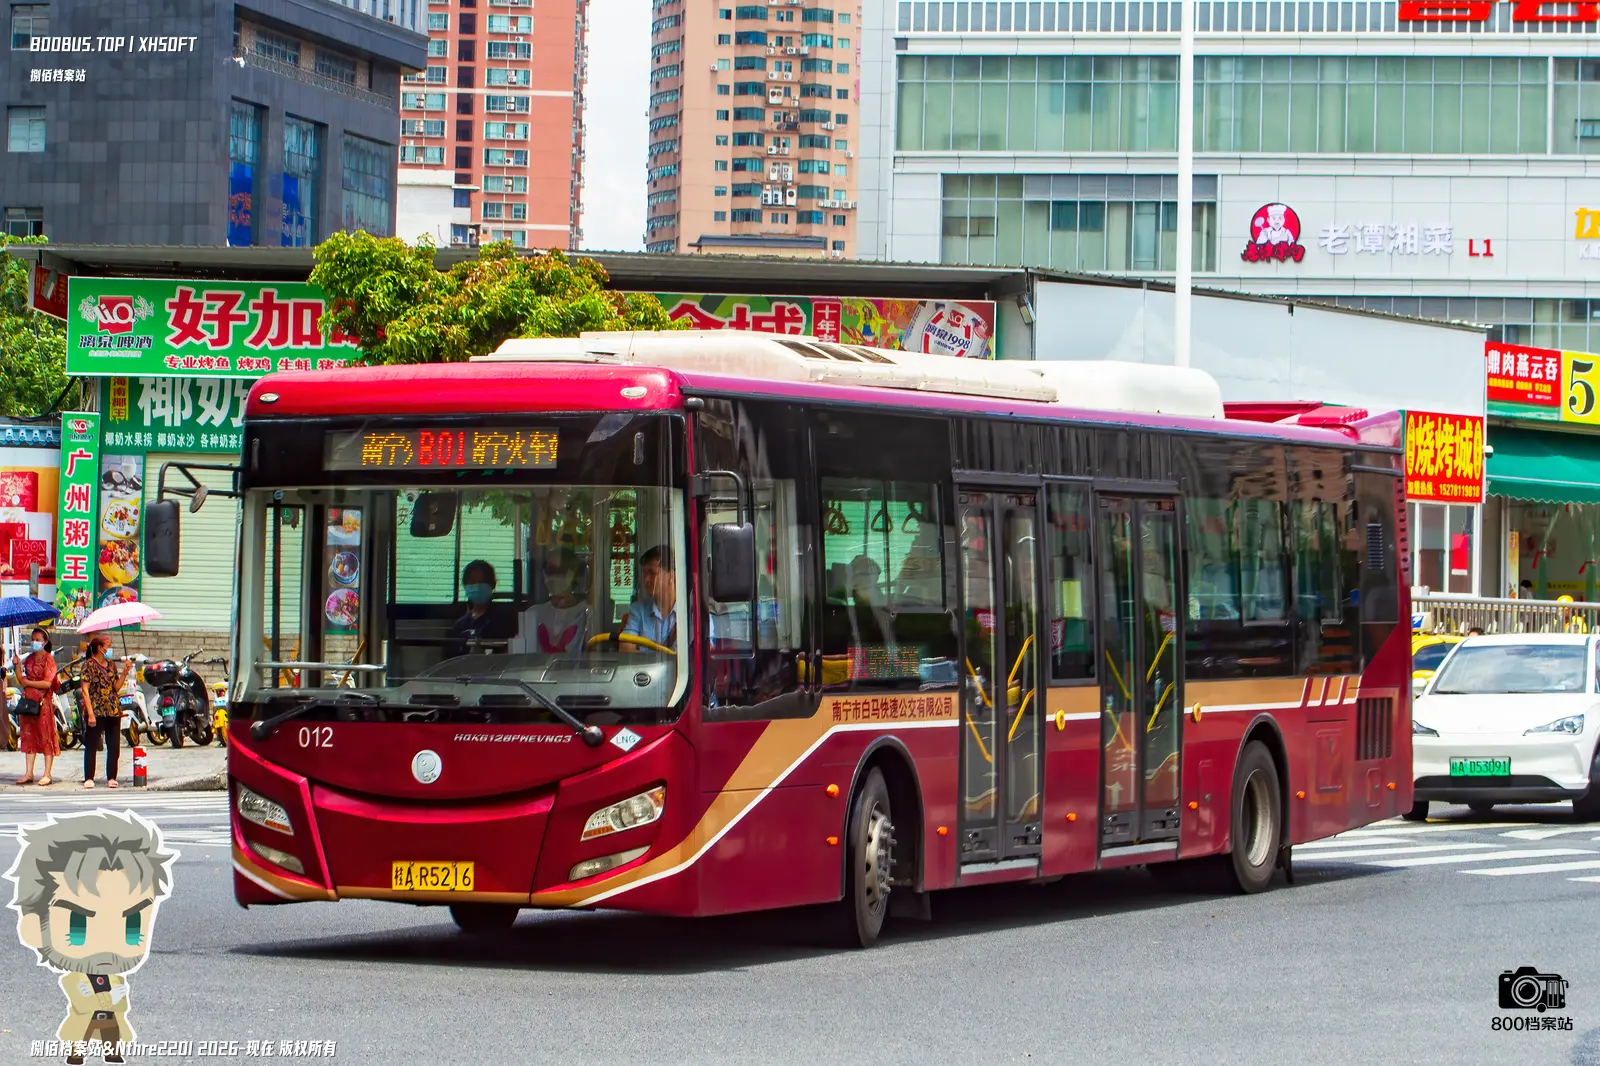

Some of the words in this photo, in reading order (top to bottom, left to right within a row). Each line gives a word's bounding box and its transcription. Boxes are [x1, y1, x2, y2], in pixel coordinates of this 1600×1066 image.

[1319, 222, 1454, 256] 老谭湘菜
[1468, 239, 1494, 257] L1
[165, 355, 231, 370] 专业烤鱼
[236, 357, 272, 371] 烤鸡
[278, 359, 311, 371] 生蚝
[1569, 360, 1595, 416] 5
[105, 432, 153, 447] 椰奶水果捞
[157, 432, 196, 448] 椰奶冰沙
[1415, 415, 1474, 480] 烧烤城
[63, 448, 92, 582] 广州粥王
[13, 541, 46, 552] MOON
[832, 696, 952, 722] 南宁市白马快速公交有限公司
[298, 726, 334, 748] 012
[616, 734, 637, 744] LNG
